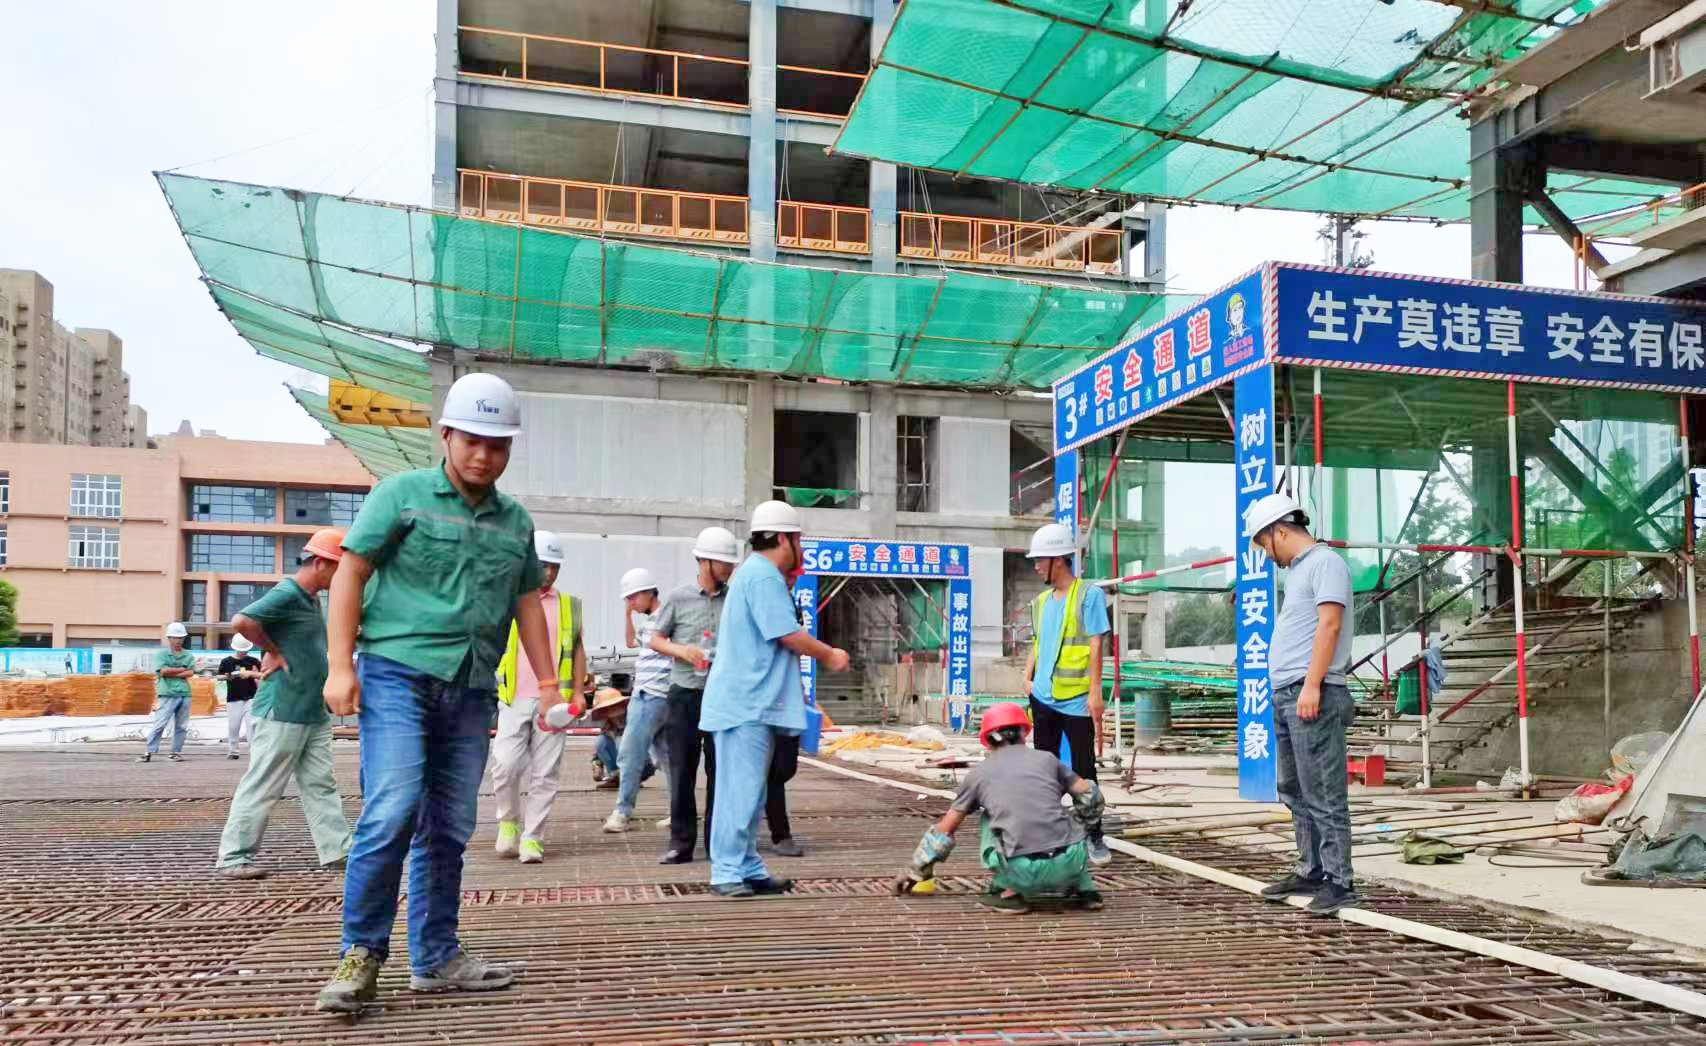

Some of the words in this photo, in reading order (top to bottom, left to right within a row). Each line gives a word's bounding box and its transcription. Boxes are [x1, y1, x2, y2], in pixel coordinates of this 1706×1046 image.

[1307, 289, 1525, 357] 生产莫违章
[1546, 311, 1705, 371] 安全有保
[1064, 391, 1088, 440] 3#
[1094, 308, 1212, 406] 安全通道
[802, 548, 844, 570] S6#
[848, 544, 941, 564] 安全通道
